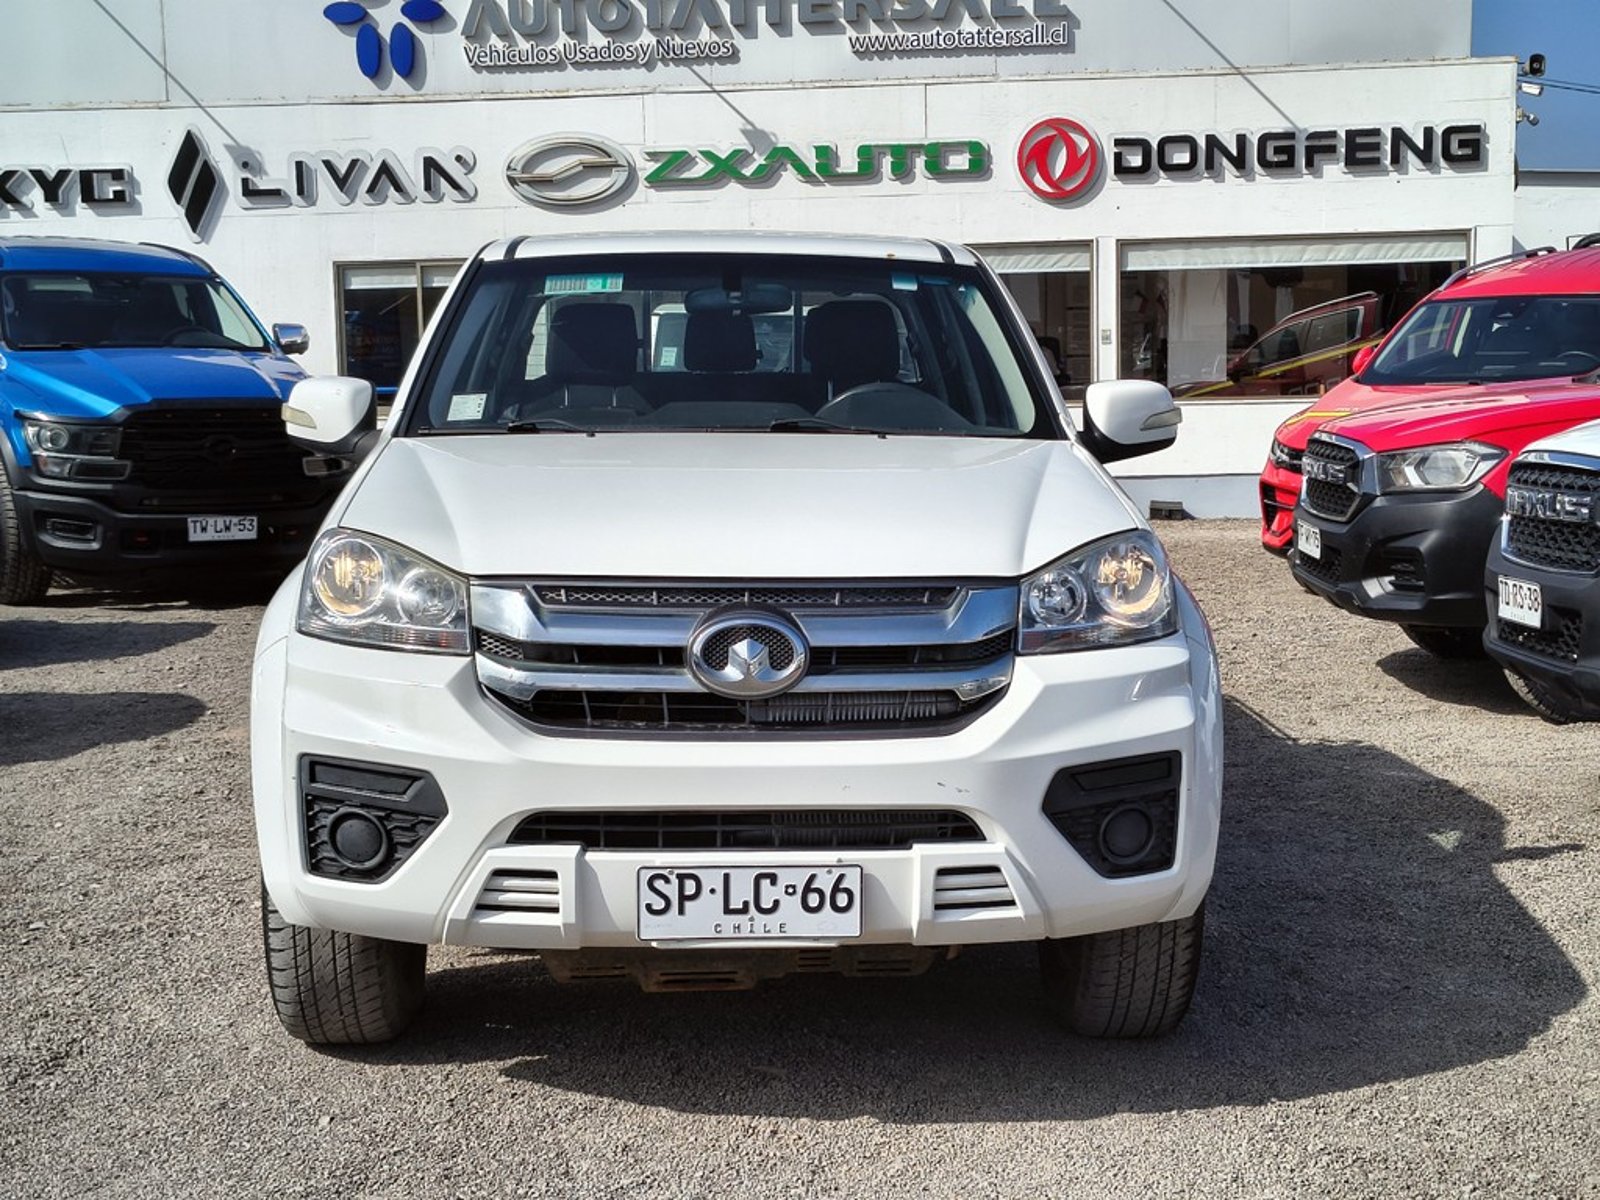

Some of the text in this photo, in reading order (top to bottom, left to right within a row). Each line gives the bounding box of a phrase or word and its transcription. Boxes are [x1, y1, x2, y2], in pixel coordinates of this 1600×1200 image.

[464, 39, 732, 65] Vehículos Usados y Nuevos
[849, 23, 1067, 50] www.autotattersall.cl
[644, 139, 988, 184] ZXAUTO
[1113, 124, 1483, 175] DONGFENG
[241, 153, 466, 197] LIVAN
[713, 923, 788, 934] CHILE
